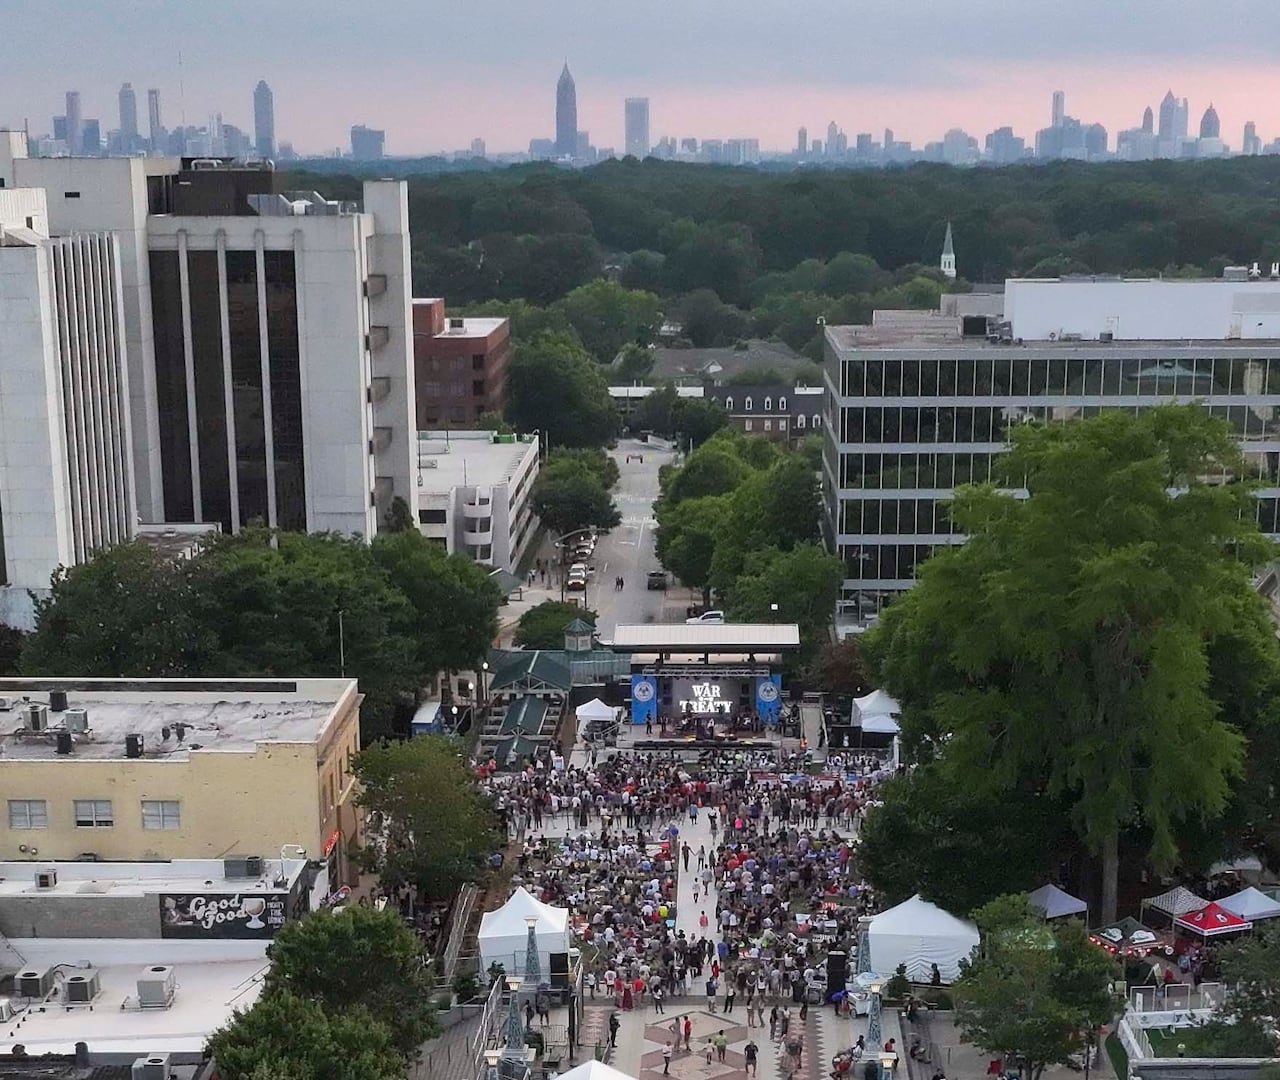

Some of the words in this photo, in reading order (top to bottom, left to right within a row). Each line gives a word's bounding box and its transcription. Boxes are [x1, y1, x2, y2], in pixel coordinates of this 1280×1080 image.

[692, 685, 721, 697] WAR
[680, 700, 733, 713] TREATY
[187, 894, 240, 919] Good
[202, 909, 247, 929] Food
